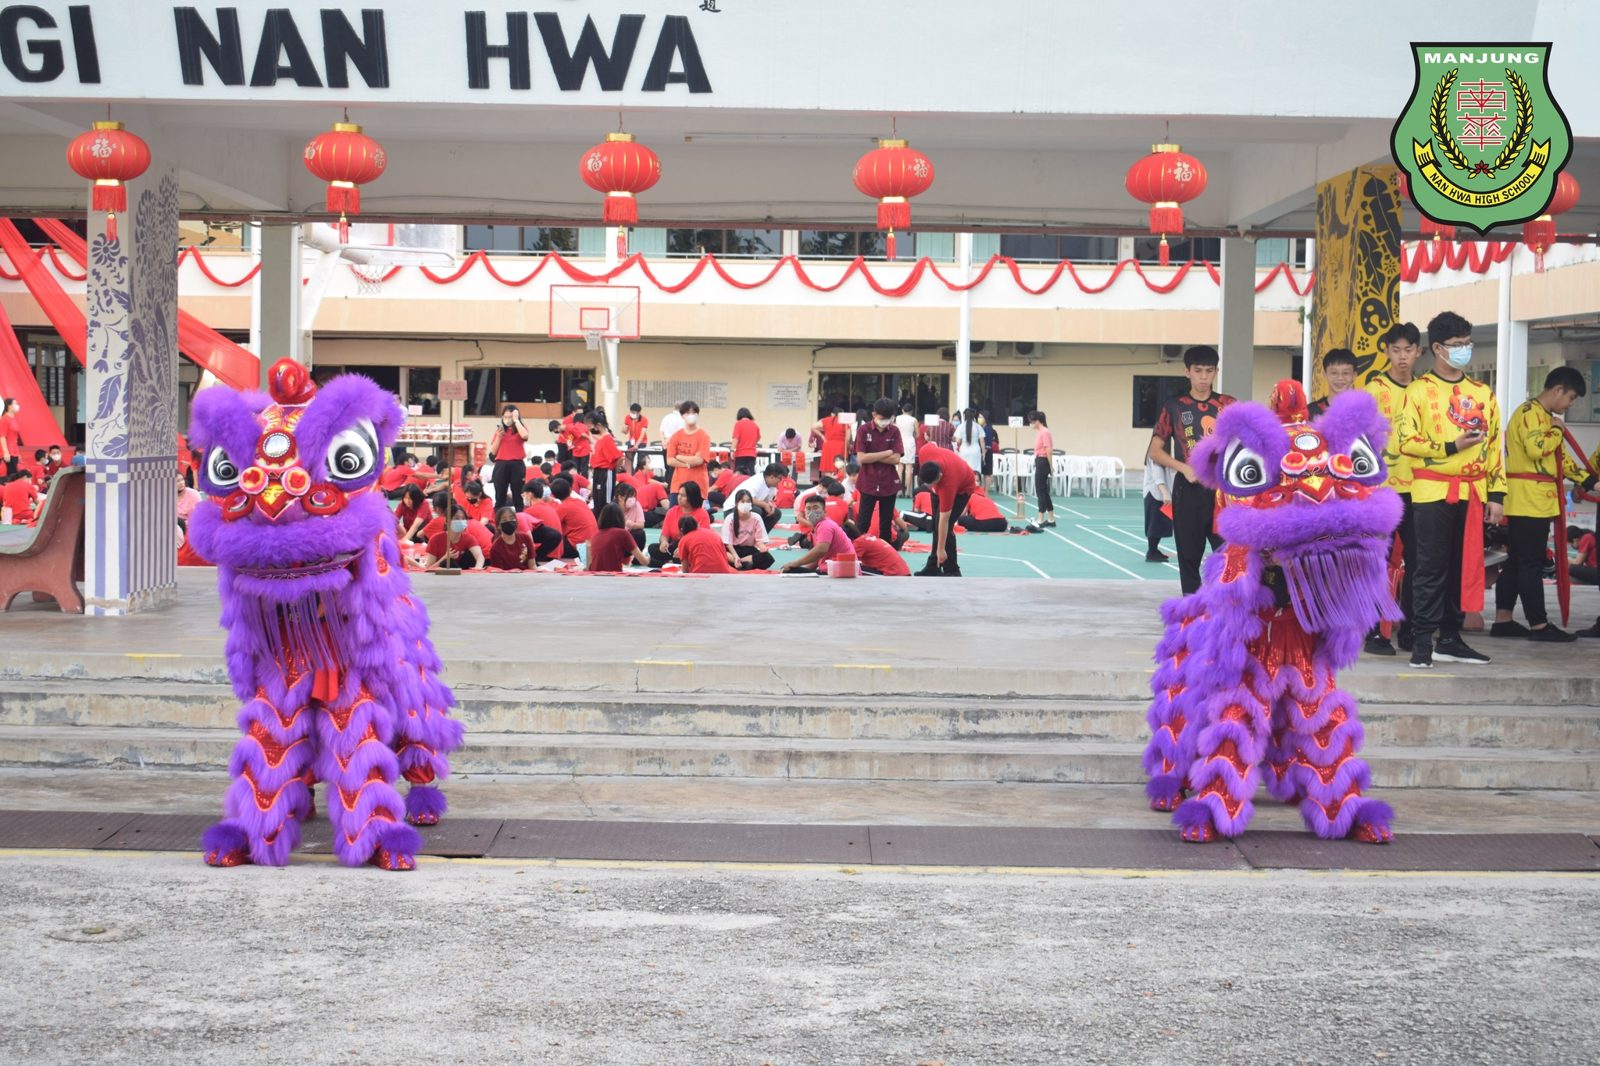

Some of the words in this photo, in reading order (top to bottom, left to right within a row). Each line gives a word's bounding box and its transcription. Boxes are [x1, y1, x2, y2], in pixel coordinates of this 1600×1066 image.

[0, 4, 101, 85] GI
[174, 6, 389, 89] NAN
[465, 10, 712, 94] HWA
[91, 138, 112, 158] 福
[586, 152, 603, 173] 福
[913, 157, 928, 178] 福
[1174, 161, 1193, 182] 福
